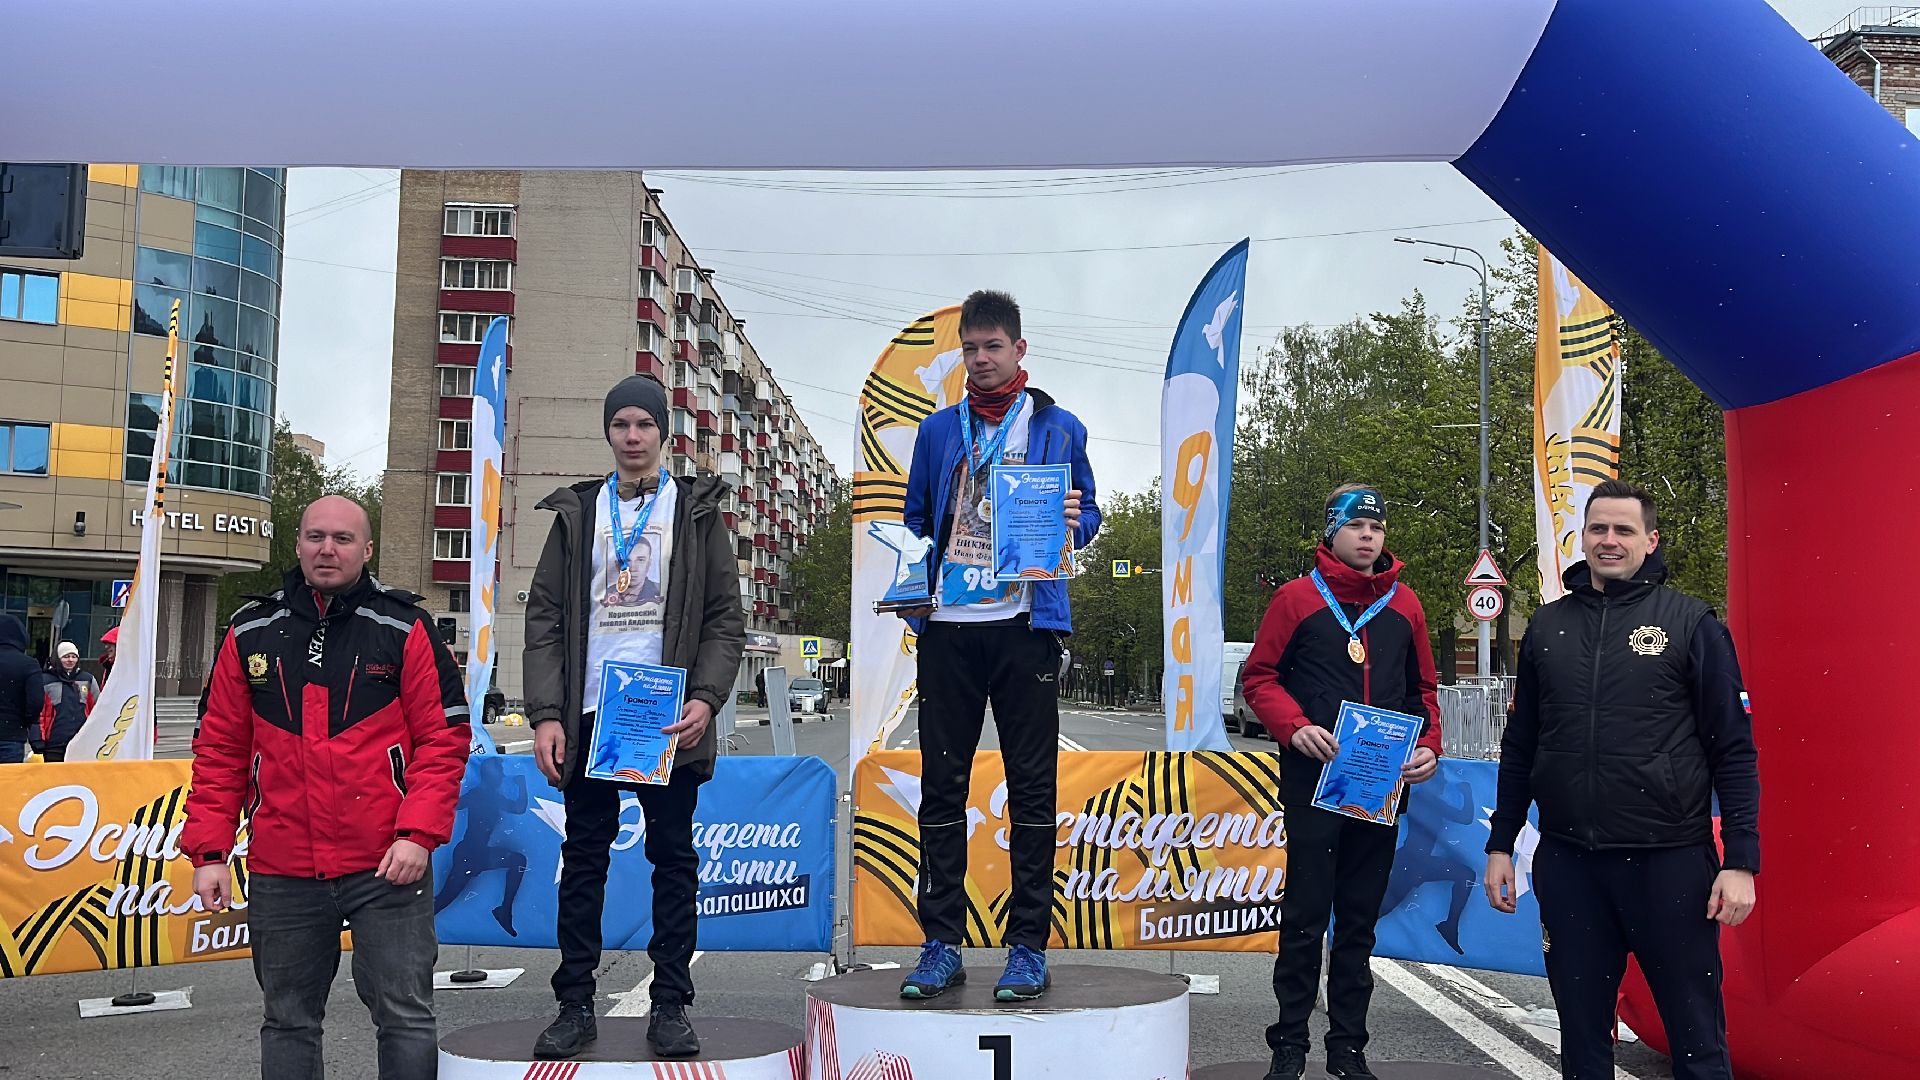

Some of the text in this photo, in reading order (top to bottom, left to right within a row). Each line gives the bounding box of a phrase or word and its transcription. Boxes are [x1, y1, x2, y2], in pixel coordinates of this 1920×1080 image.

[1172, 430, 1212, 542] 9
[1015, 498, 1048, 506] Грамота
[131, 509, 205, 531] HTEL
[214, 513, 258, 535] EAST
[956, 539, 992, 550] НИКИФ
[963, 567, 999, 592] 98
[1475, 597, 1496, 610] 40
[624, 694, 658, 706] Грамота
[1357, 737, 1390, 750] Грамота
[1063, 865, 1285, 902] памяти
[1139, 905, 1281, 941] Балаших
[978, 1035, 1012, 1080] 1
